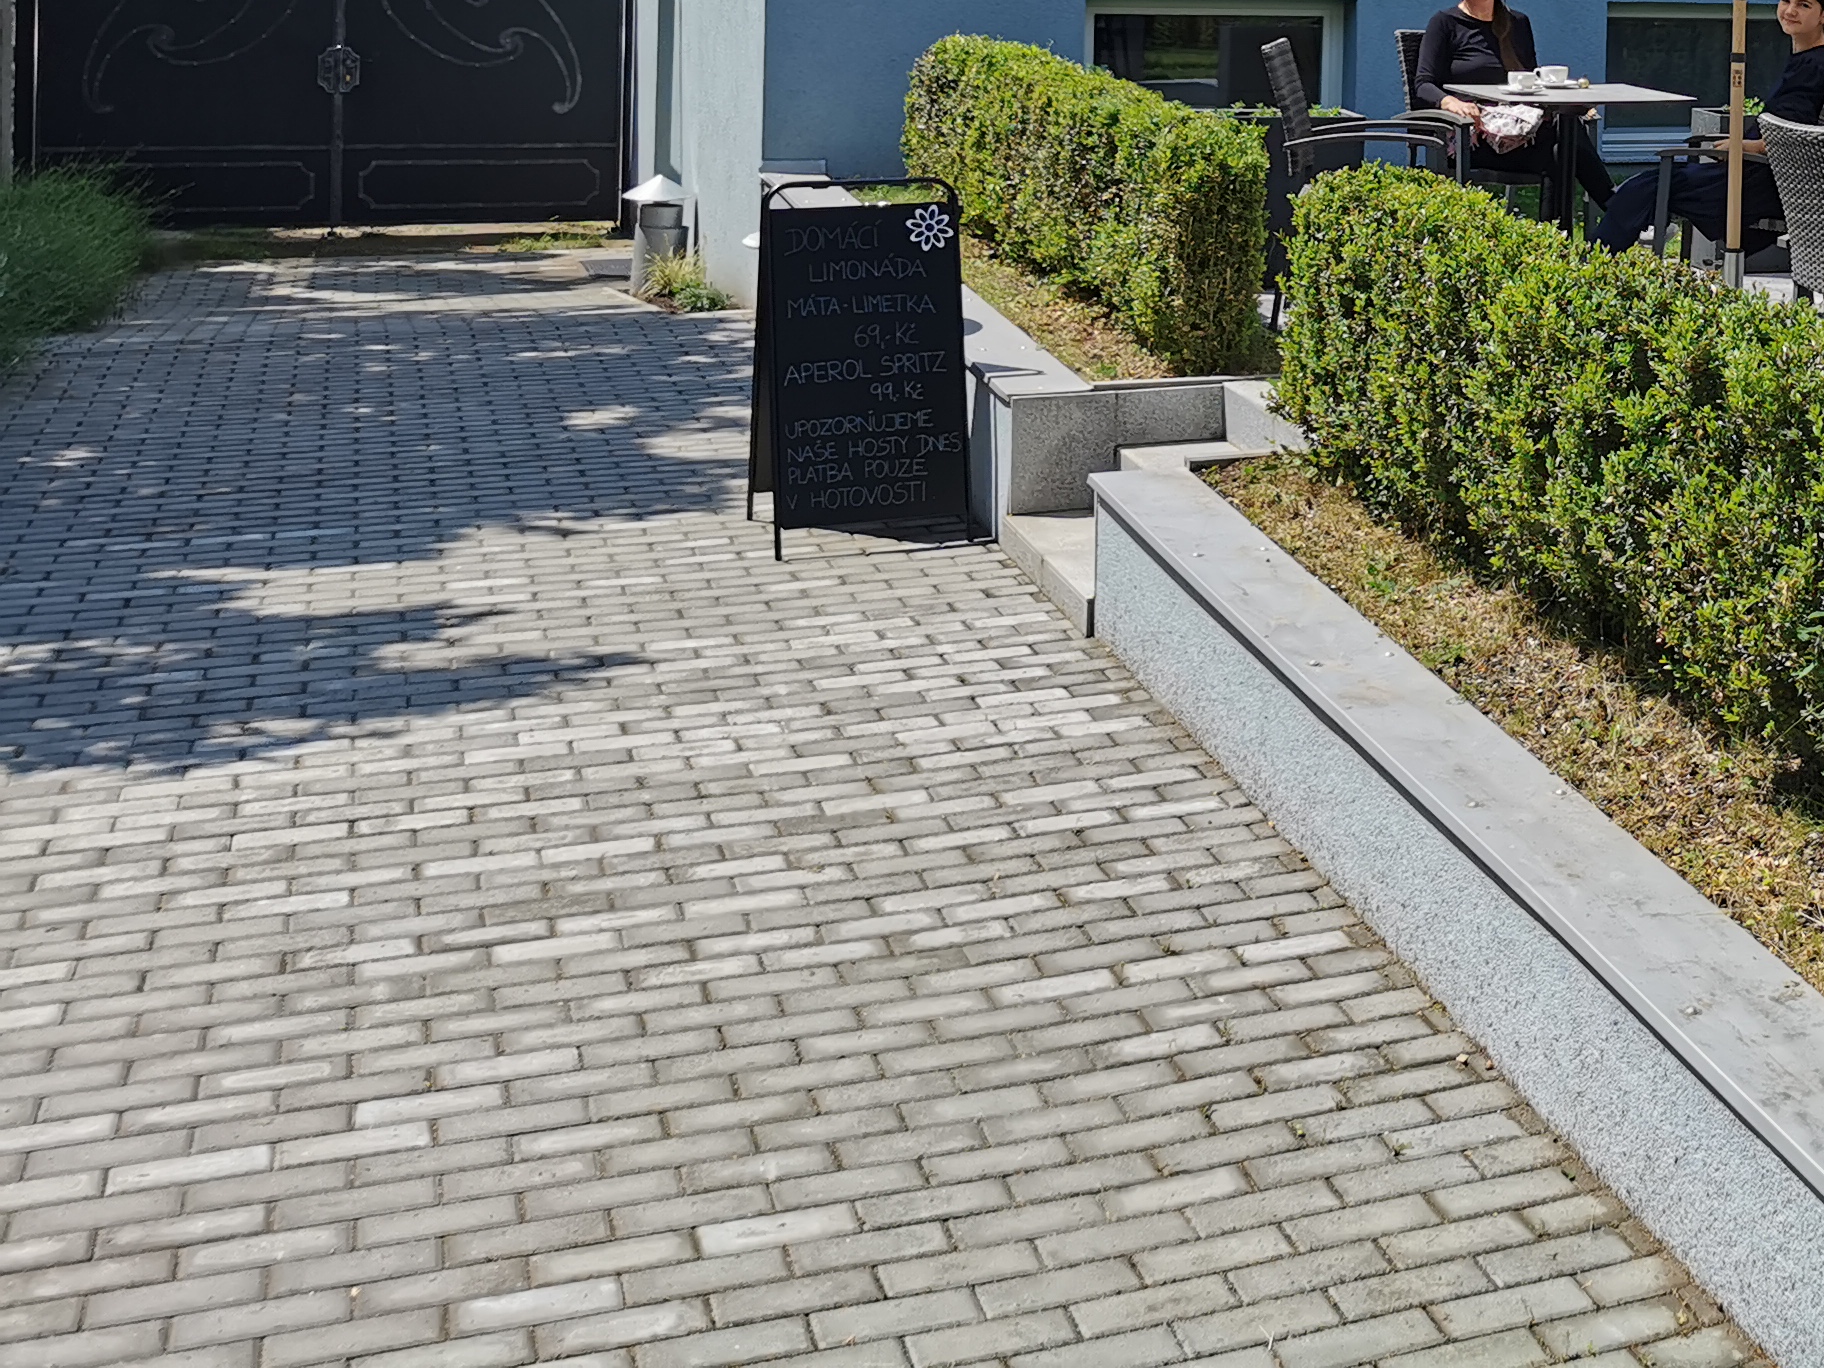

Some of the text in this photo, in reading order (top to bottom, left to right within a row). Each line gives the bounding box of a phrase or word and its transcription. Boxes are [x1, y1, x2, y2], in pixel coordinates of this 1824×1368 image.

[808, 253, 927, 282] LIMONÁDA
[784, 351, 947, 386] APEROL SPRITZ
[787, 432, 962, 463] NAŠE HOSTY DNES
[787, 458, 928, 485] PLATBA POUZE
[785, 494, 798, 510] V
